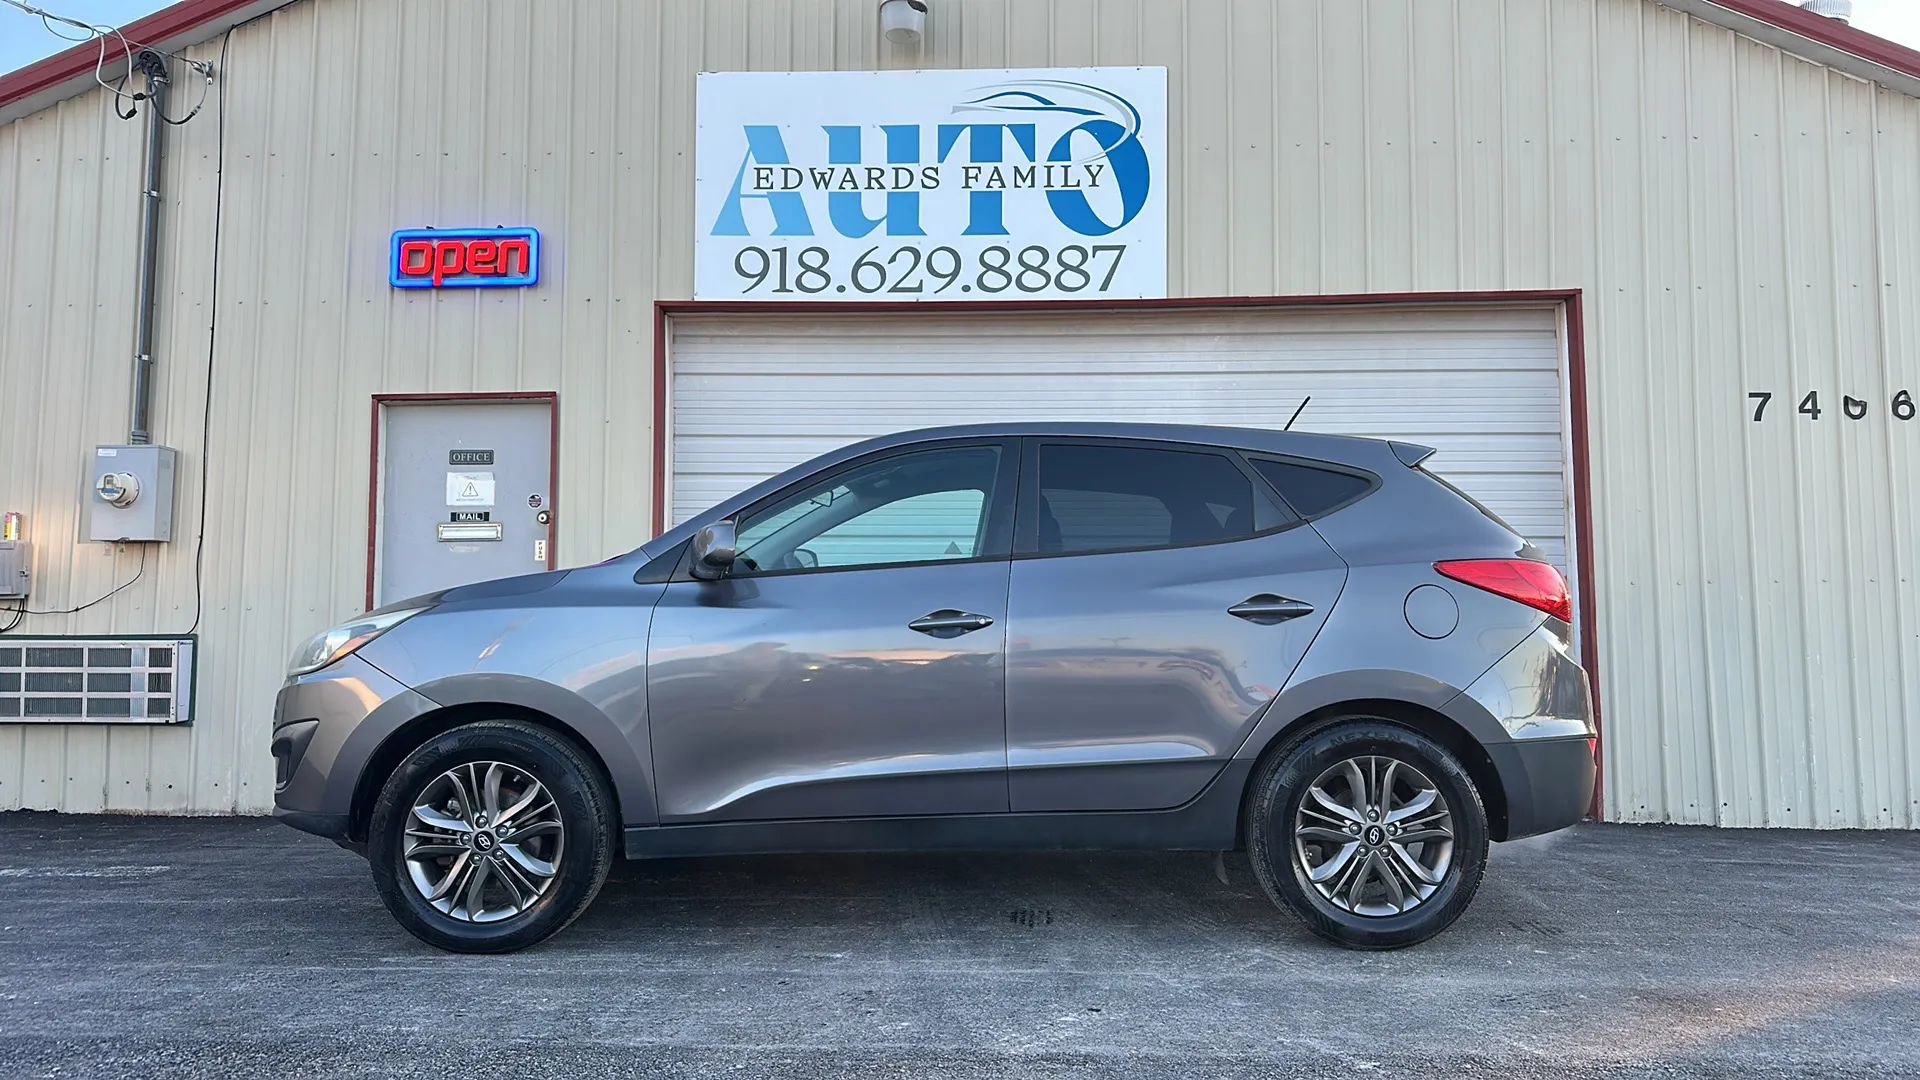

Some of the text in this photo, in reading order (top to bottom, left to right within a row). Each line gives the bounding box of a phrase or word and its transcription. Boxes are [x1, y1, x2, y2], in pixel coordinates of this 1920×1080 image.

[753, 164, 1105, 190] EDWARDS FAMILY
[400, 240, 528, 287] open
[734, 244, 1127, 295] 918.629.8887
[452, 452, 491, 462] OFFICE
[459, 512, 481, 521] MAIL
